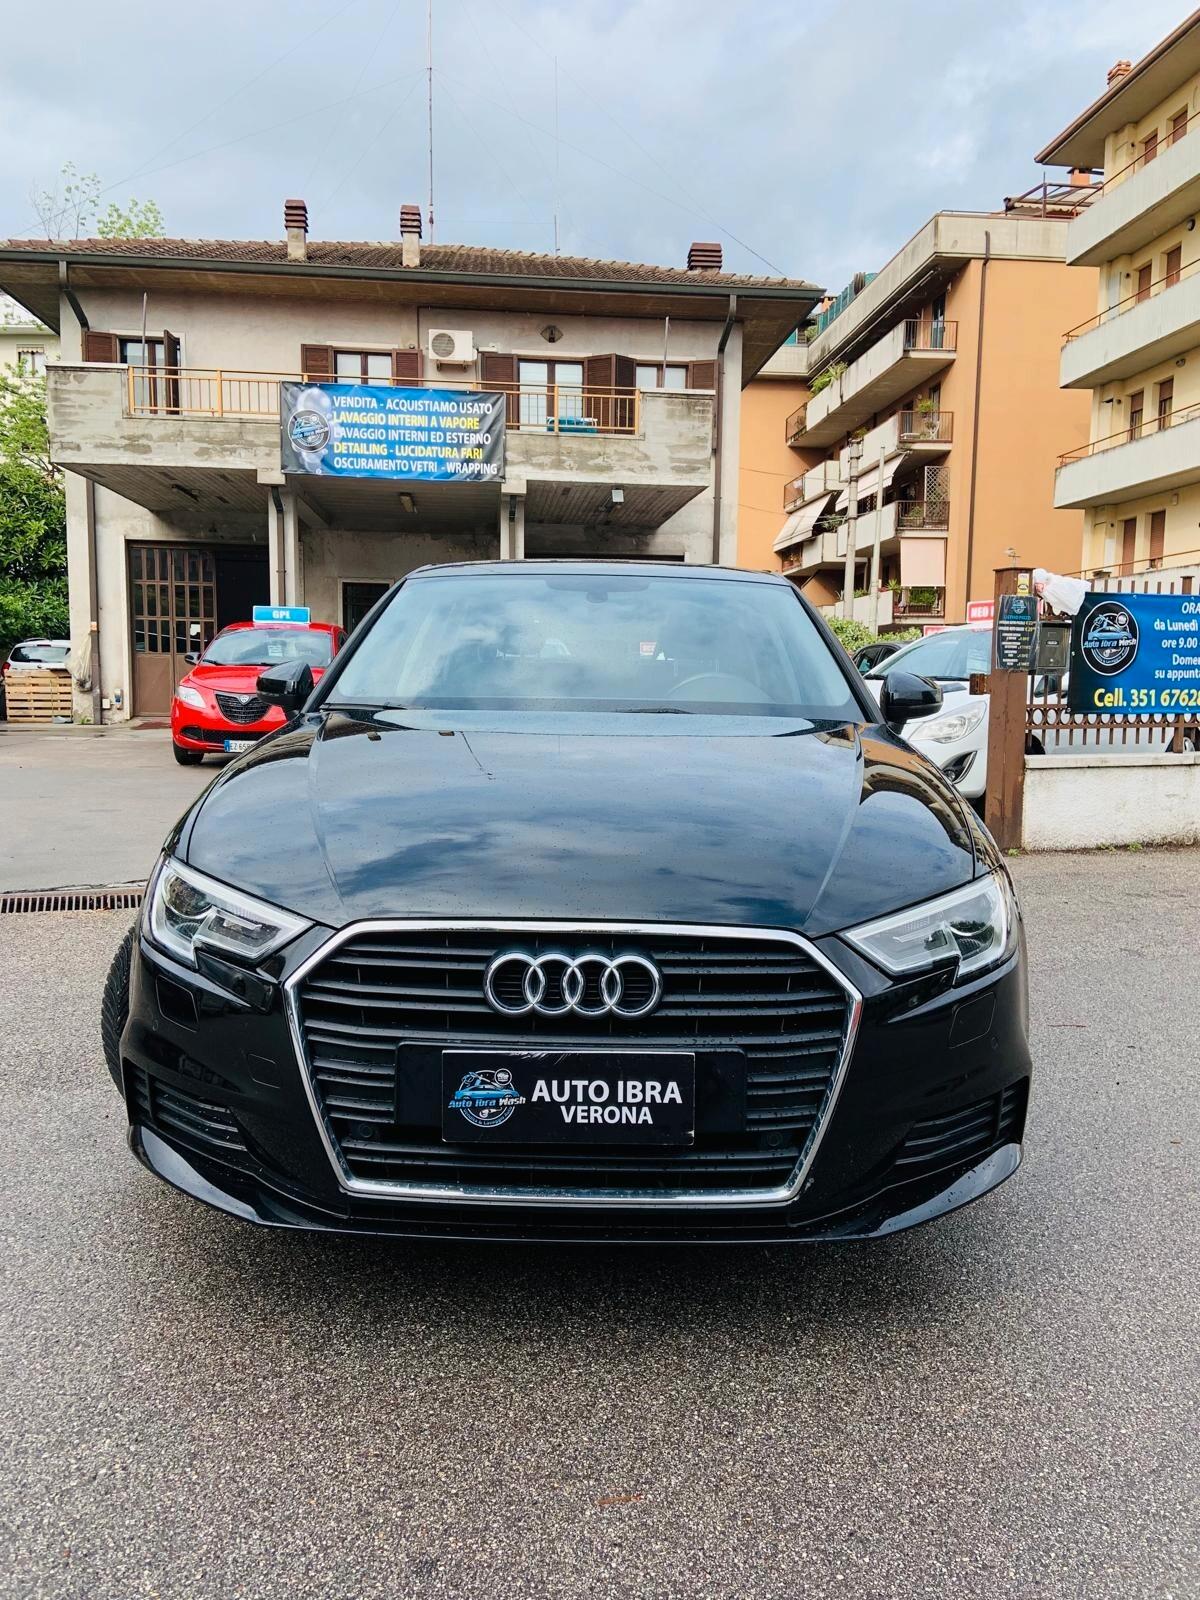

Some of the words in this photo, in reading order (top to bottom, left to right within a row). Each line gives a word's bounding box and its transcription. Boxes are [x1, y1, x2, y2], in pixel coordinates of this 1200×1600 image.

[333, 396, 377, 409] VENDITA
[386, 399, 457, 413] ACQUISTIAMO
[460, 402, 492, 414] USATO
[333, 410, 386, 424] LAVAGGIO
[388, 414, 428, 427] INTERNI
[430, 417, 438, 427] A
[439, 417, 479, 429] VAPORE
[333, 427, 386, 440] LAVAGGIO
[388, 429, 428, 442] INTERNI
[430, 431, 444, 443] ED
[446, 433, 491, 445] ESTERNO
[334, 442, 387, 455] DETAILING
[395, 445, 459, 459] LUCIDATURA
[460, 447, 483, 460] FARI
[334, 456, 409, 471] OSCURAMENTO
[410, 460, 437, 472] VETRI
[446, 462, 498, 475] WRAPPING
[271, 610, 291, 620] GPL
[1154, 619, 1166, 631] da
[1167, 619, 1199, 631] Lunedì
[1161, 640, 1177, 649] ore
[1178, 637, 1198, 649] 9.00
[1154, 670, 1165, 679] su
[1093, 688, 1127, 707] Cell.
[1130, 689, 1156, 707] 351
[531, 1079, 609, 1103] AUTO
[617, 1080, 683, 1104] IBRA
[448, 1099, 473, 1108] Auto
[474, 1098, 497, 1107] Ibra
[498, 1096, 527, 1106] Wash
[560, 1105, 653, 1124] VERONA
